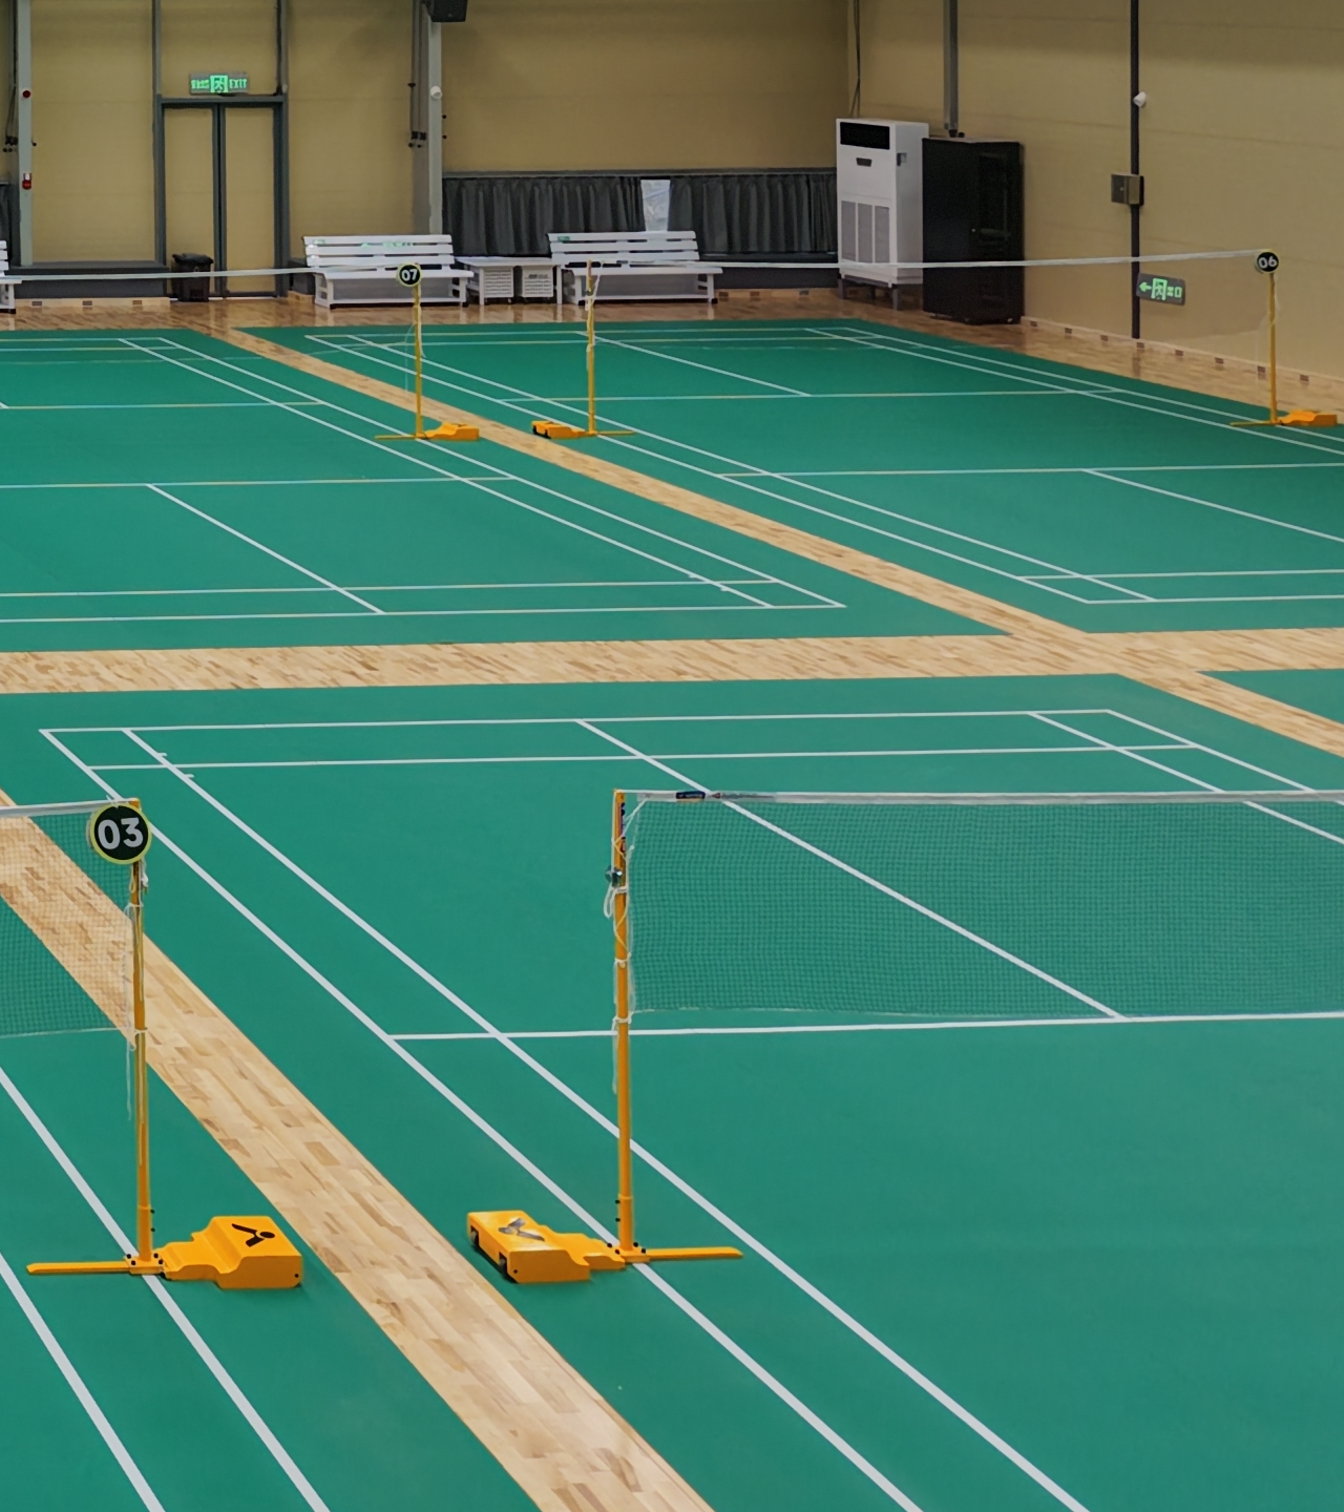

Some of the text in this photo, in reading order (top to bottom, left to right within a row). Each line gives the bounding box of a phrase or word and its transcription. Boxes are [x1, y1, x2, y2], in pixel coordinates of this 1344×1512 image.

[229, 79, 247, 89] EXIT
[1258, 256, 1278, 269] 06
[401, 268, 418, 281] 07
[97, 817, 144, 851] 03
